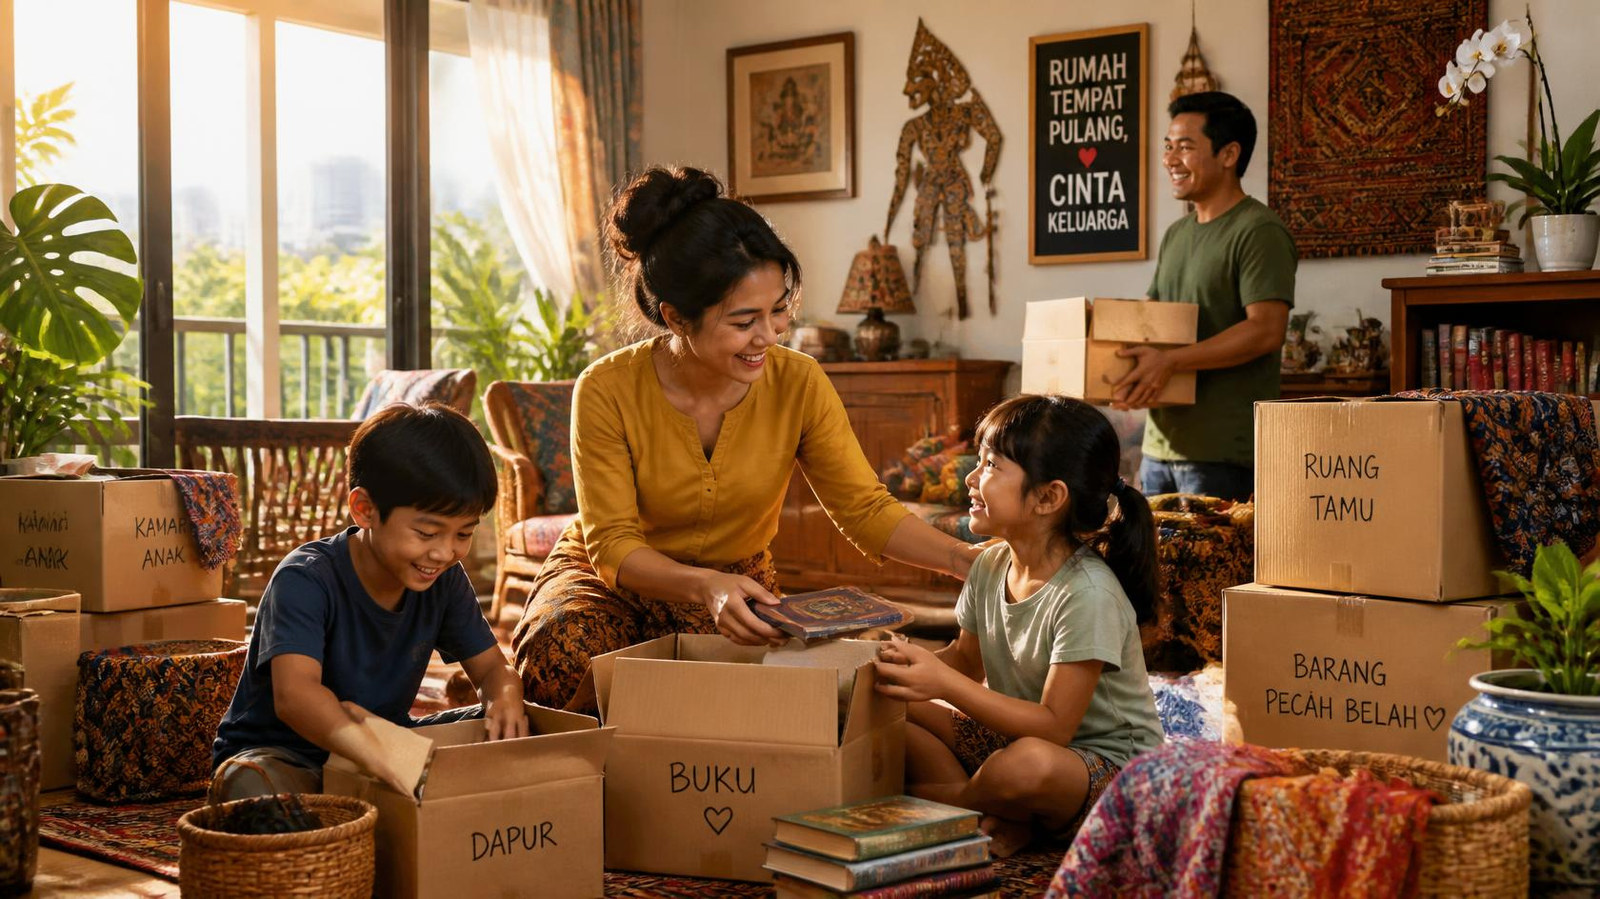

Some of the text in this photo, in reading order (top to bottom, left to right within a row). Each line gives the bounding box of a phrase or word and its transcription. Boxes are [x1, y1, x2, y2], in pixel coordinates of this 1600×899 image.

[1049, 52, 1127, 86] RUMAH
[1050, 84, 1126, 115] TEMPAT
[1049, 115, 1128, 145] PULANG,
[1049, 170, 1126, 206] CINTA
[1047, 208, 1129, 233] KELUARGA
[1304, 452, 1380, 480] RUANG
[1309, 494, 1374, 522] TAMU
[141, 545, 186, 571] ANAK
[1293, 653, 1387, 686] BARANG
[1345, 698, 1417, 730] BELAH
[669, 761, 756, 794] BUKU
[471, 821, 558, 861] DAPUR
